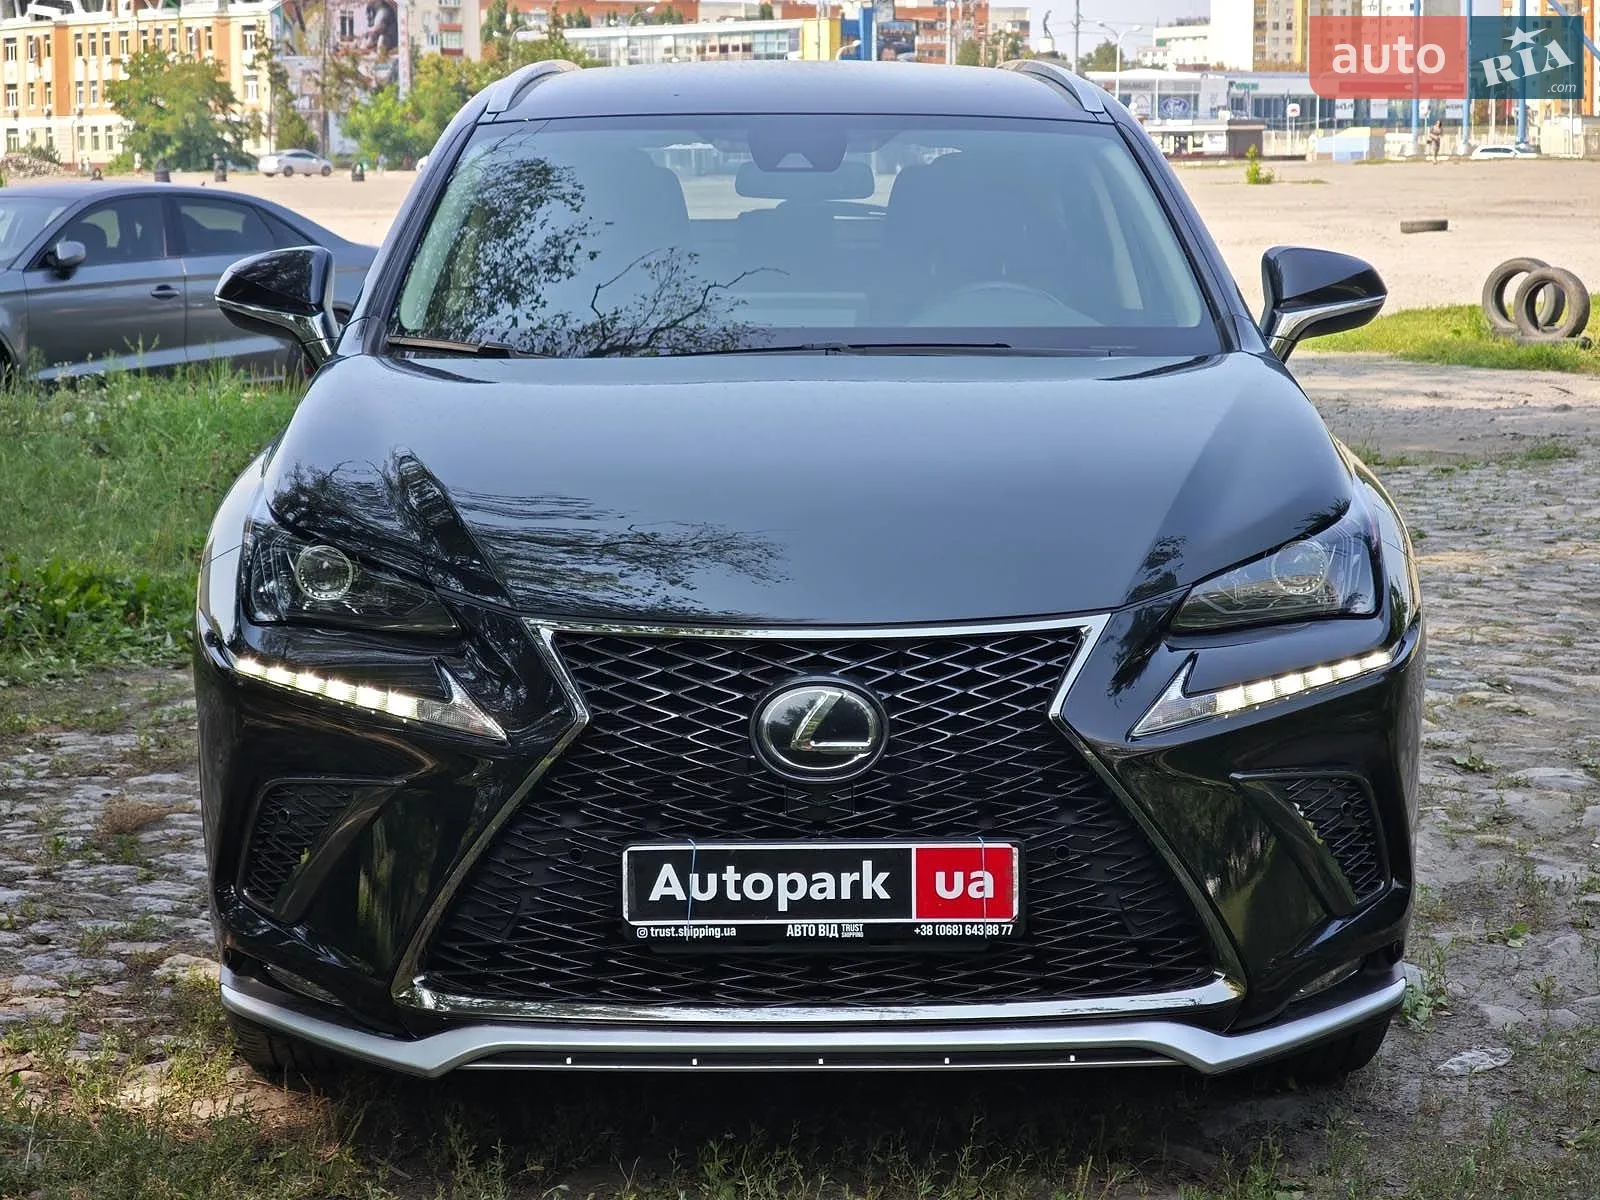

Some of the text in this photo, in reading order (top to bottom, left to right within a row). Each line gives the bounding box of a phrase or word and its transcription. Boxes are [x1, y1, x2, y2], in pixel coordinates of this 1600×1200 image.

[648, 860, 995, 911] Autopark ua
[650, 924, 737, 938] trust.shipping.ua
[786, 923, 839, 938] АВТО ВІД
[841, 923, 864, 932] TRUST
[914, 924, 1014, 936] +38 (068) 643 88 77
